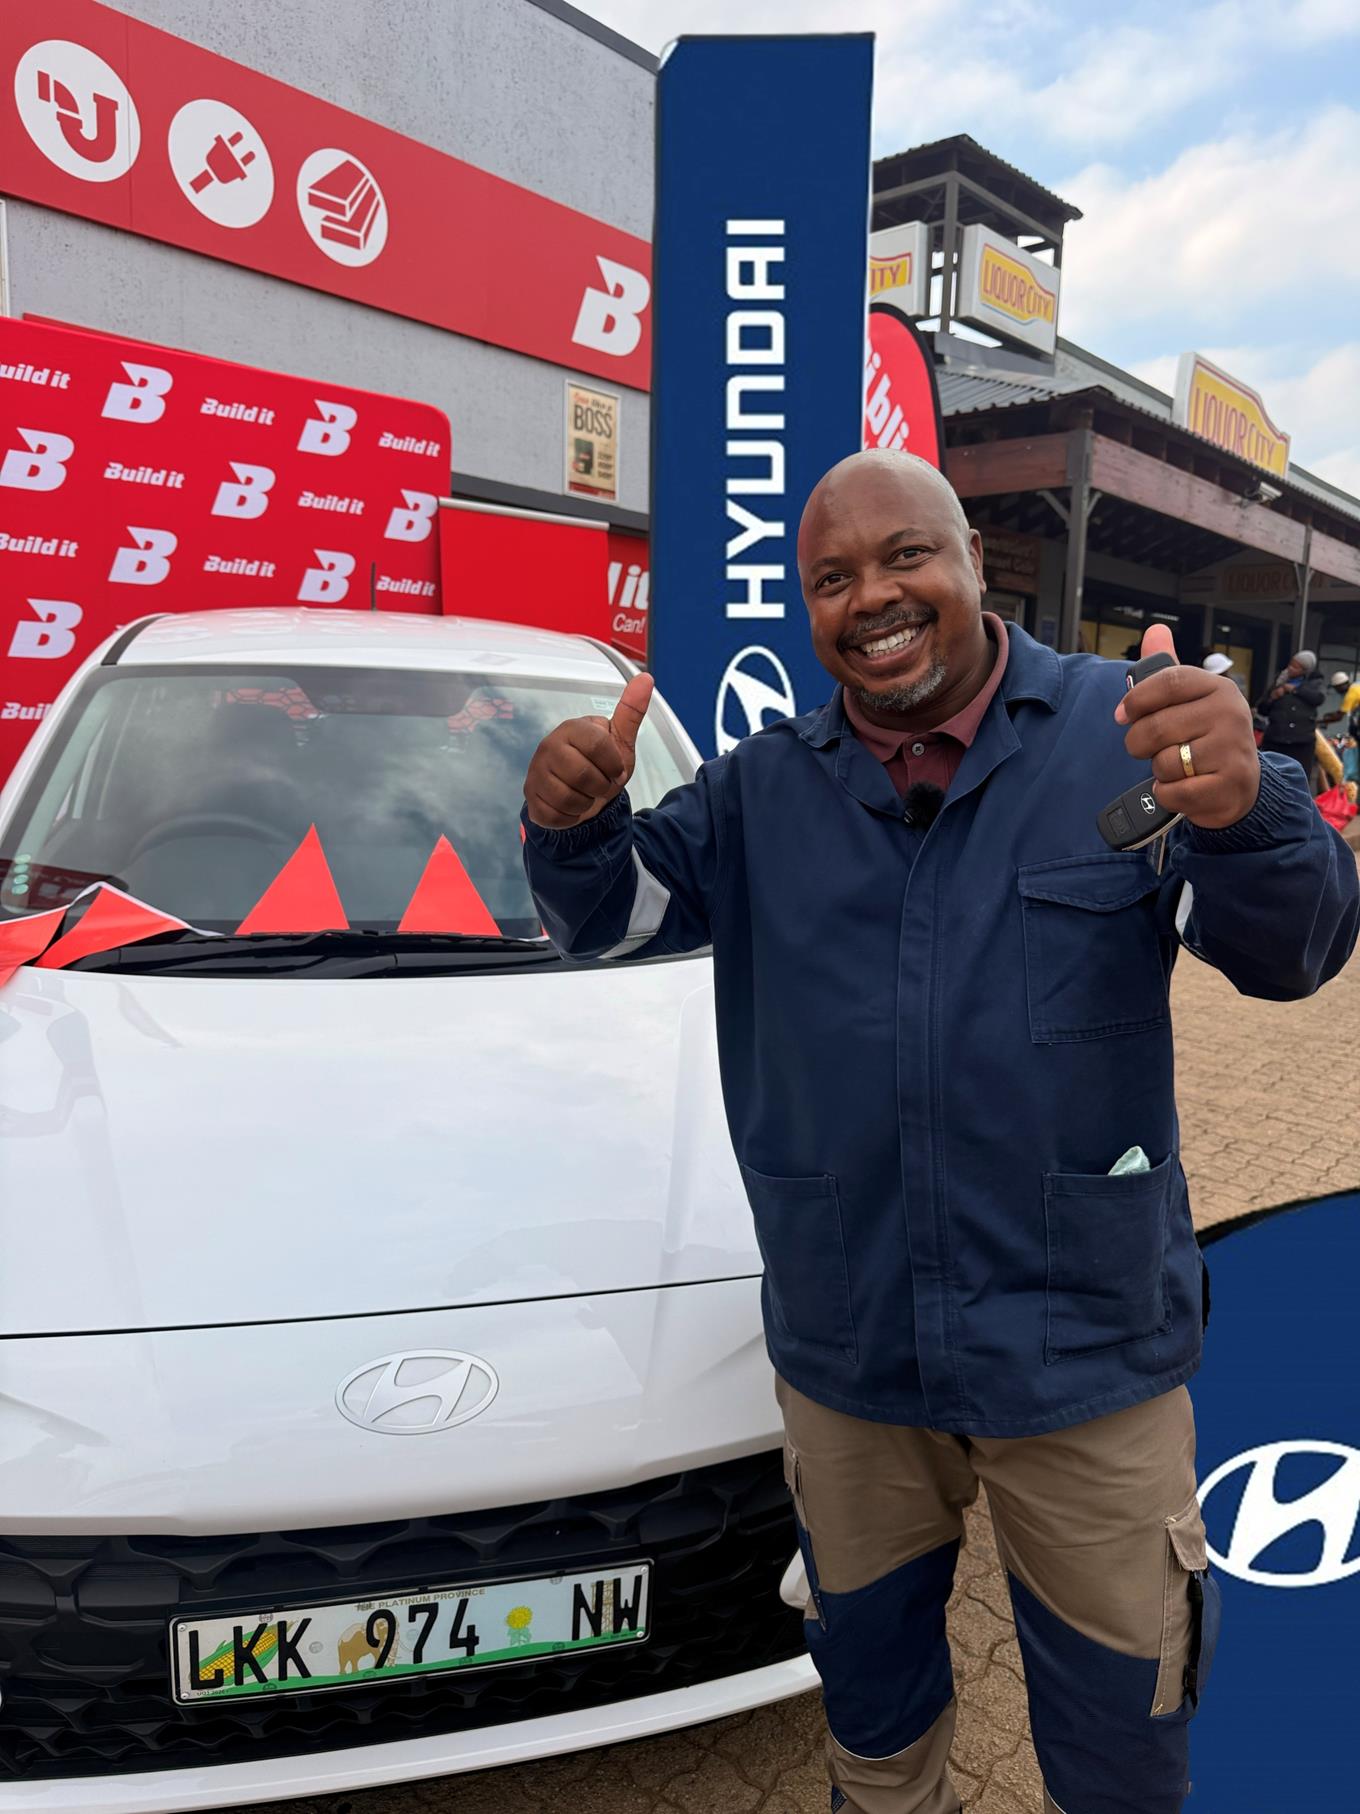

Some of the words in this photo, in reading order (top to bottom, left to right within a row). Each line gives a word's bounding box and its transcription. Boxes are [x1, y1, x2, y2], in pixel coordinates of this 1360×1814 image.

[869, 264, 901, 291] ITY
[983, 260, 1024, 309] LIQUOR
[1024, 285, 1051, 317] CITY
[572, 255, 651, 357] B
[0, 363, 50, 385] uild
[51, 370, 71, 389] it
[101, 361, 174, 424] B
[200, 398, 259, 422] Build
[258, 408, 275, 426] it
[297, 399, 358, 457] B
[574, 404, 613, 438] BOSS
[726, 219, 785, 618] HYUNDAI
[1193, 387, 1247, 457] LIQUOR
[1247, 423, 1276, 466] CITY
[0, 427, 75, 492] B
[378, 432, 427, 454] Build
[426, 441, 440, 457] it
[103, 462, 167, 486] Build
[166, 471, 185, 489] it
[211, 461, 276, 520] B
[298, 491, 351, 513] Build
[349, 499, 365, 515] it
[58, 539, 79, 558] it
[108, 526, 178, 585] B
[203, 555, 260, 576] Build
[259, 561, 276, 578] it
[297, 549, 356, 603] B
[376, 576, 423, 595] Build
[421, 582, 435, 596] it
[7, 598, 83, 659] B
[1, 702, 52, 720] Buil
[378, 1596, 431, 1609] PLATINUM
[433, 1588, 486, 1601] PROVINCE
[189, 1618, 312, 1690] LKK
[365, 1598, 480, 1670] 974
[572, 1575, 642, 1641] NW
